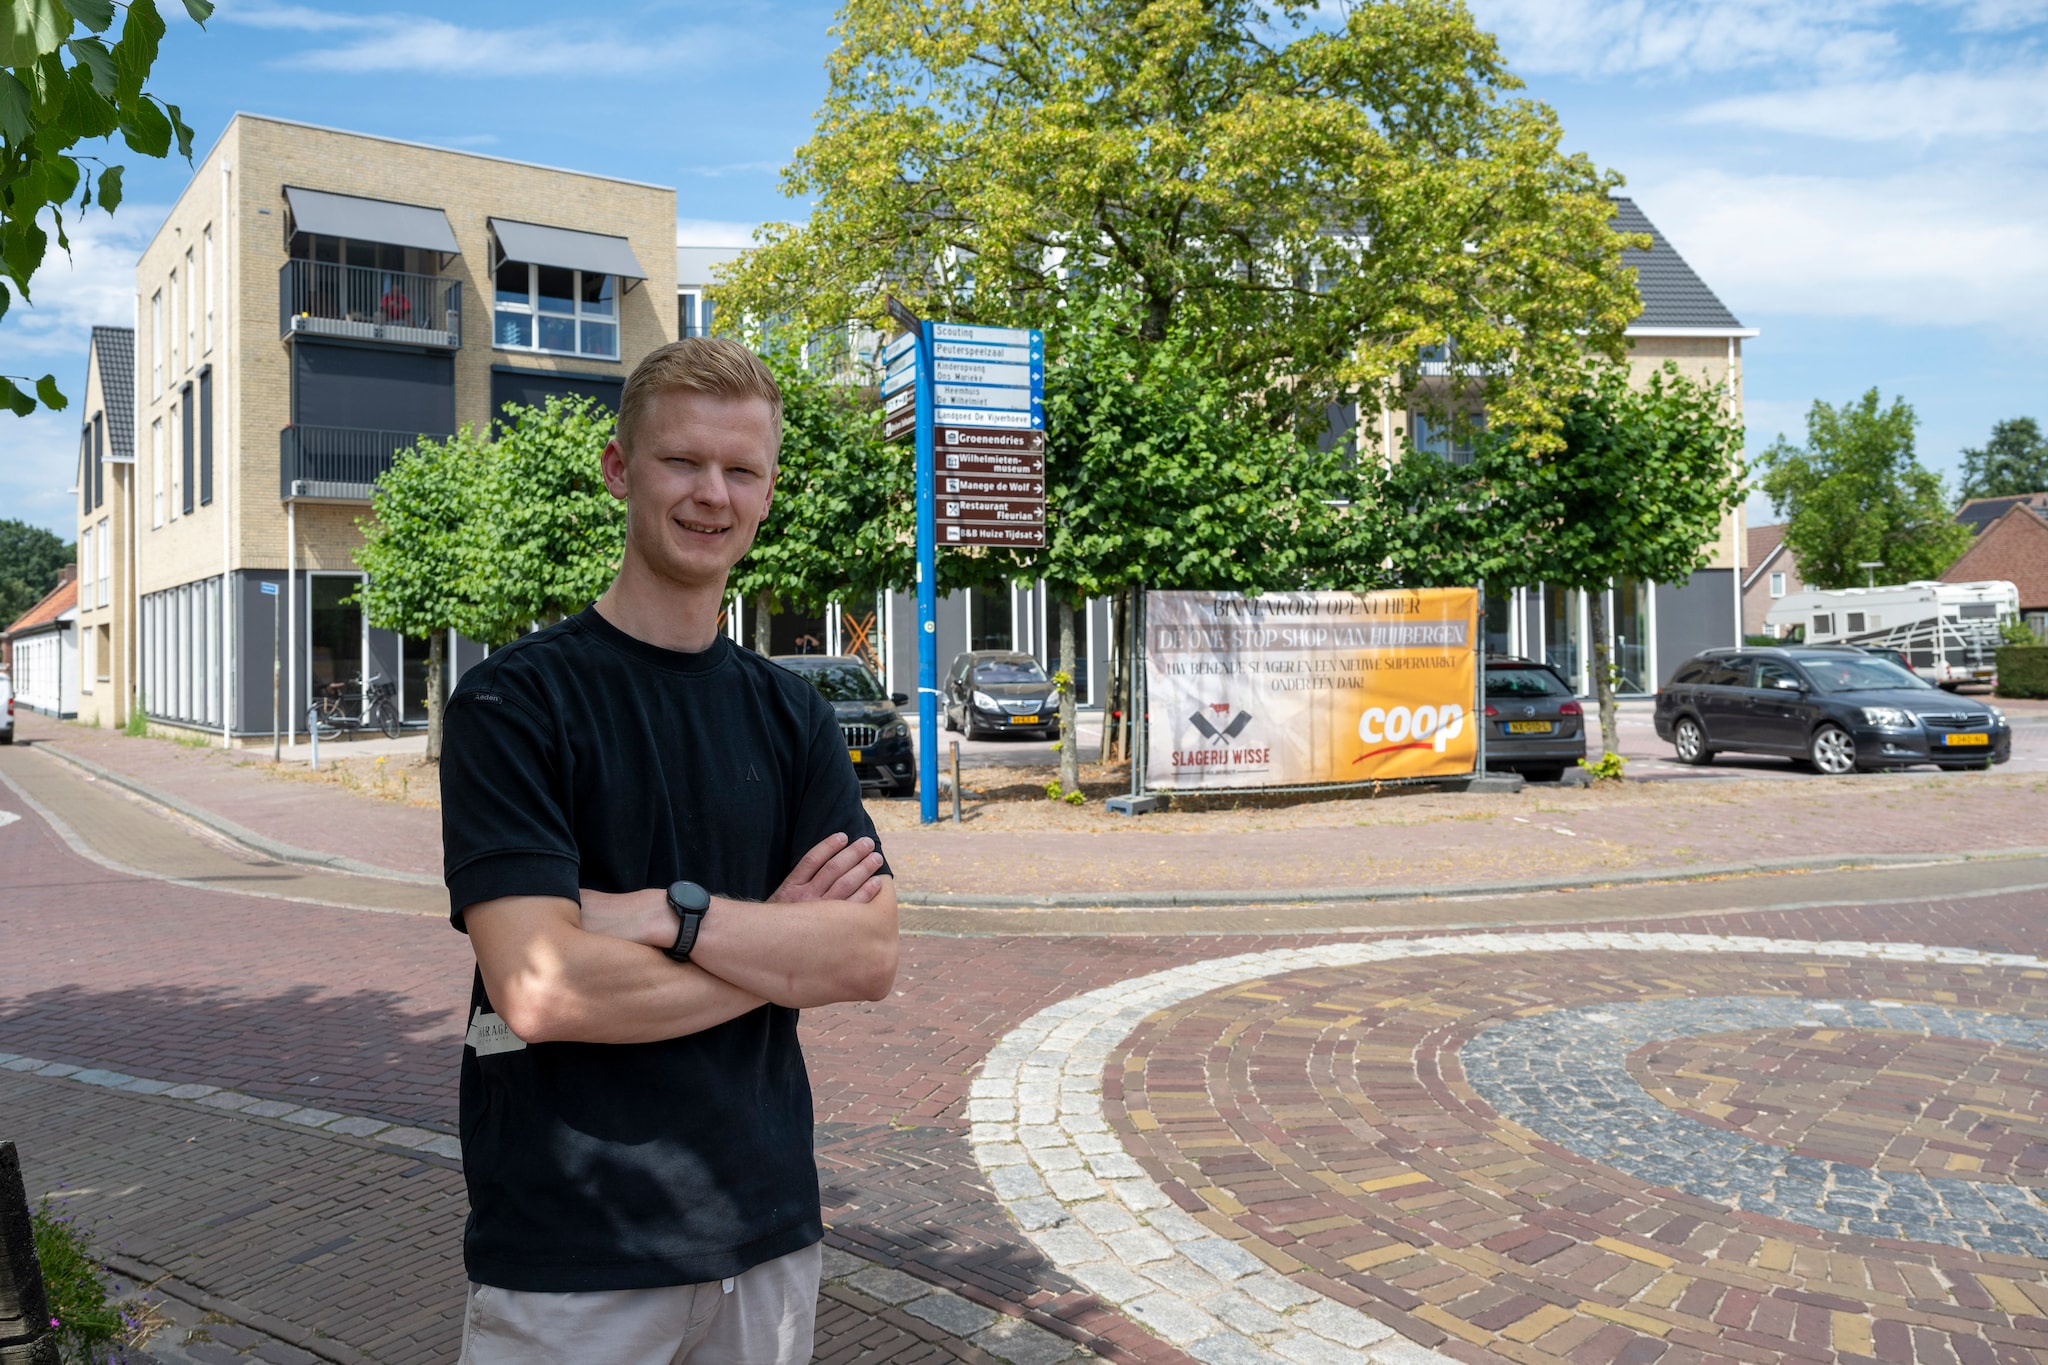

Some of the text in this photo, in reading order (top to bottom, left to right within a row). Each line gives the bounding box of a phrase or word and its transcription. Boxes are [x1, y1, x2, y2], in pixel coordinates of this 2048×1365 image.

[936, 326, 973, 339] Scouting
[936, 343, 1005, 357] Peuterspeelzaal
[937, 362, 986, 374] Kinderopvang
[937, 372, 983, 382] Ons Marieke
[944, 386, 980, 396] Heemhuis
[936, 395, 947, 404] De
[937, 410, 972, 421] Landgoed
[974, 412, 984, 421] De
[959, 433, 1025, 446] Groenendries
[993, 465, 1031, 474] museum
[960, 481, 1031, 492] Manege de Wolf
[960, 501, 1009, 511] Restaurant
[996, 511, 1033, 521] Fleurian
[960, 528, 978, 538] B&B
[979, 529, 1004, 539] Huize
[1213, 597, 1421, 617] BINNENKORT OPENT HIER
[1282, 628, 1328, 648] SHOP
[1332, 627, 1366, 646] VAN
[1369, 625, 1466, 646] HUIJBERGEN
[1167, 656, 1457, 675] UW BEKENDE SLAGER EN EEN NIEUWE SUPERMARKT
[1271, 677, 1312, 691] ONDER
[1337, 676, 1364, 689] DAK!
[1358, 704, 1464, 753] coop
[1171, 748, 1270, 767] SLAGERIJ WISSE
